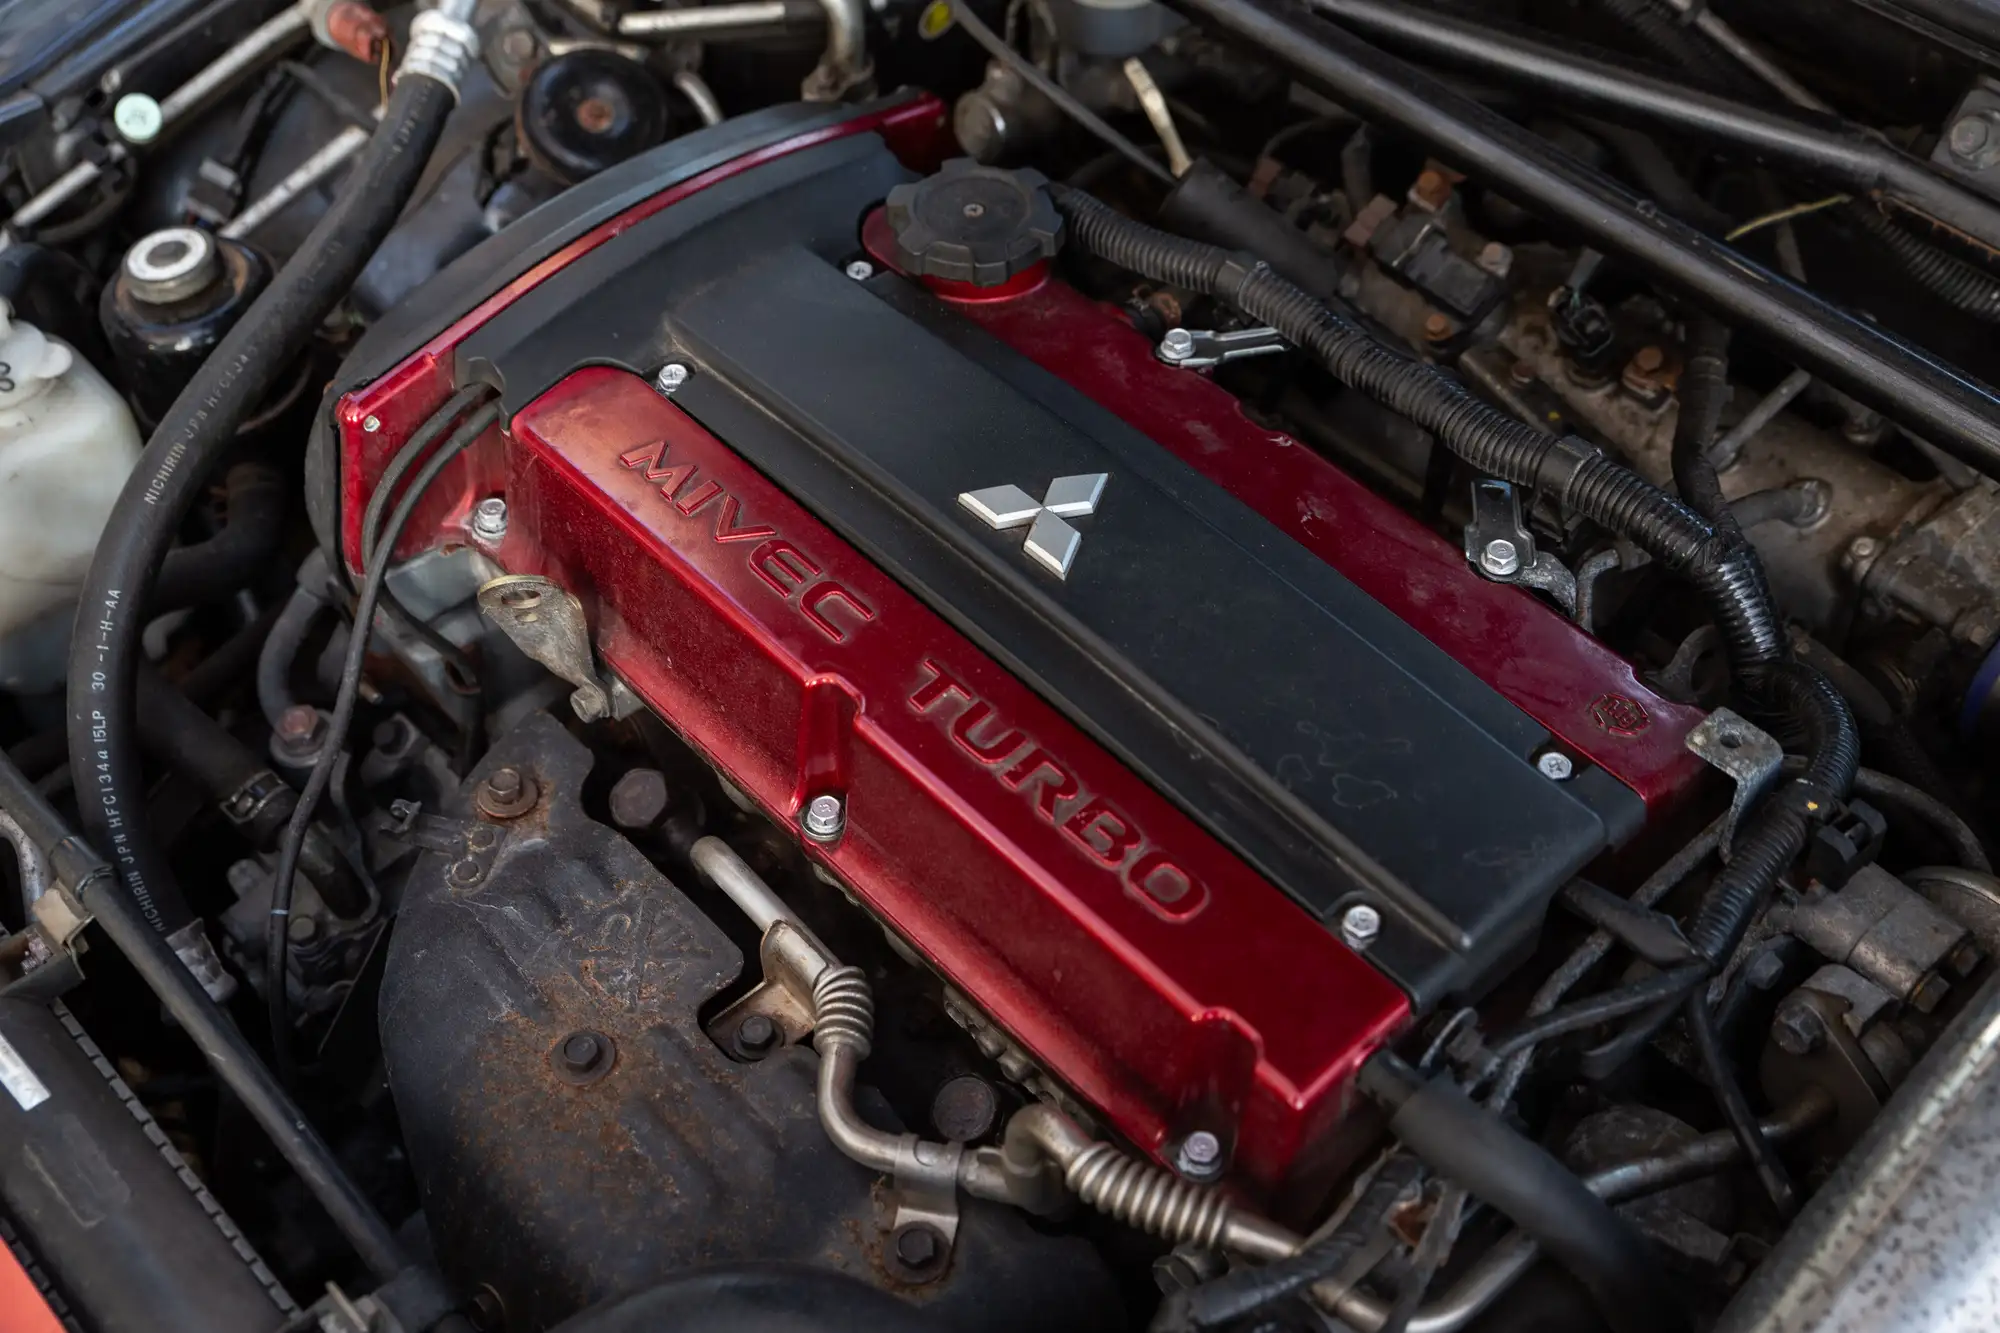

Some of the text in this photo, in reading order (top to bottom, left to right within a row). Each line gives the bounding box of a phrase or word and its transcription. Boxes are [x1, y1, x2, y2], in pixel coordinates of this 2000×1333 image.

[143, 441, 187, 505] NICHIRIN
[92, 671, 106, 691] 30
[619, 439, 1210, 924] MIVEC TURBO
[92, 710, 106, 743] 15LP
[96, 750, 123, 828] HFC134a
[113, 833, 135, 864] JPN
[127, 870, 166, 932] NICHIRIN
